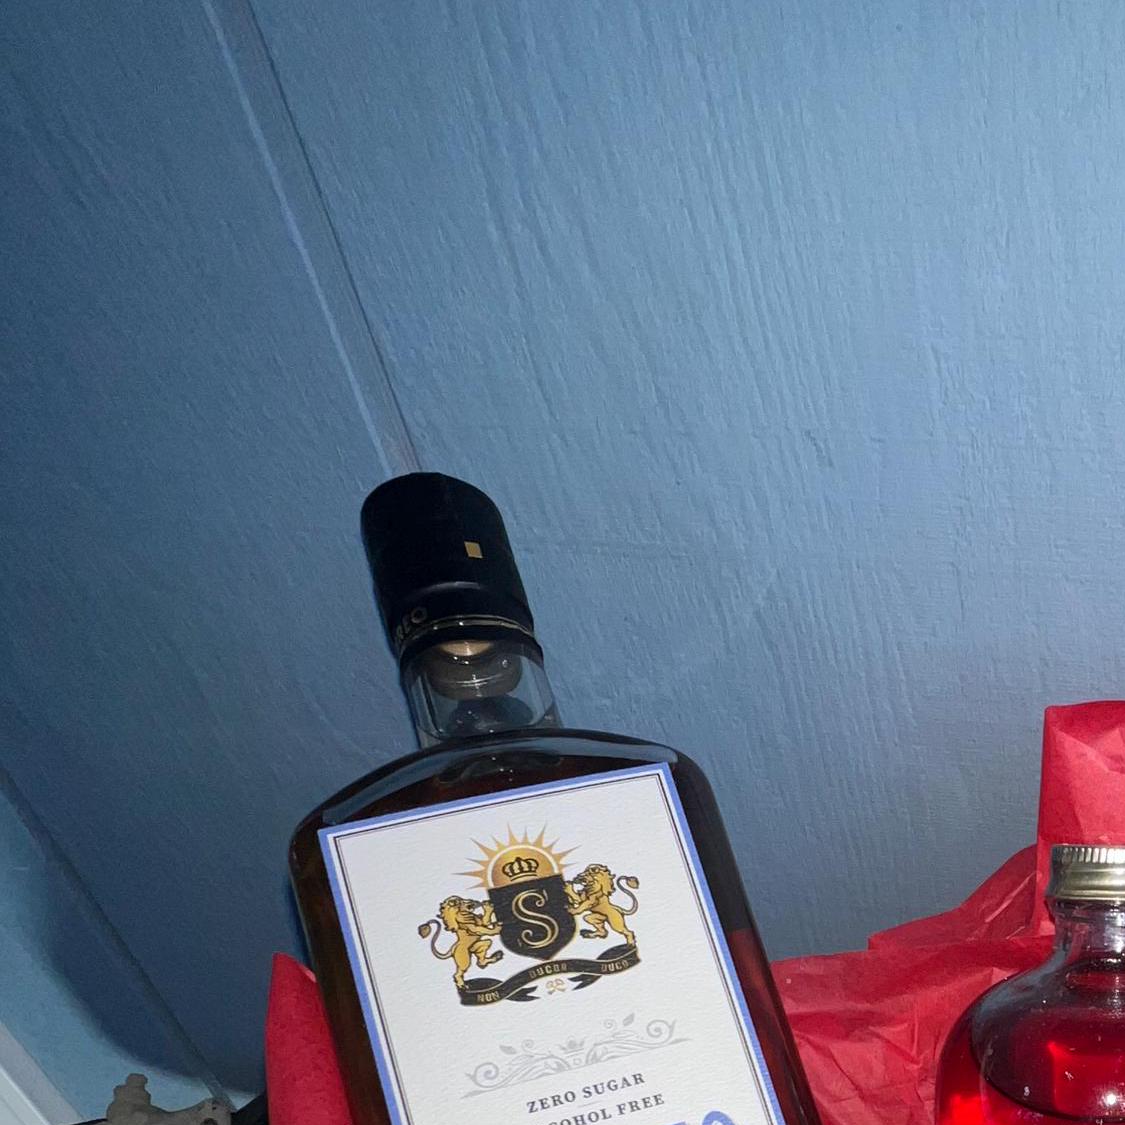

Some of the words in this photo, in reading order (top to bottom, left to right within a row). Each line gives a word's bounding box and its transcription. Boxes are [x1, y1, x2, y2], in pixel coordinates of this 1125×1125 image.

[526, 1089, 577, 1113] ZERO
[582, 1072, 646, 1099] SUGAR
[616, 1093, 665, 1116] FREE
